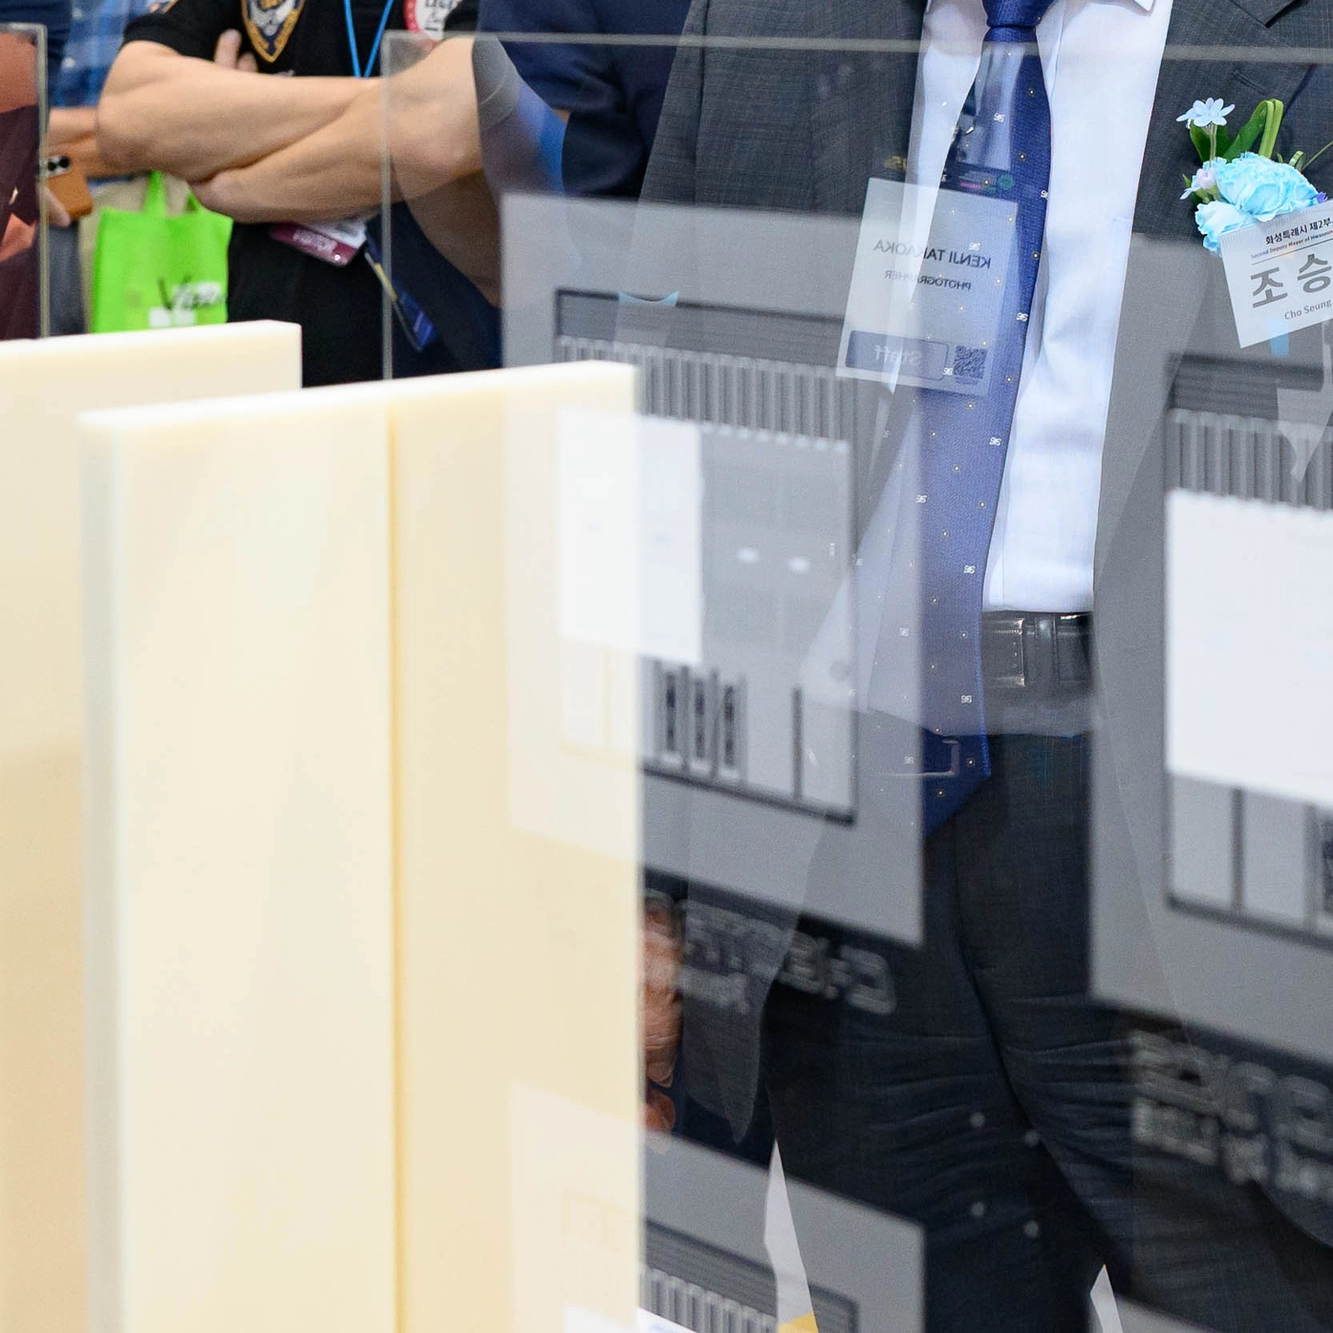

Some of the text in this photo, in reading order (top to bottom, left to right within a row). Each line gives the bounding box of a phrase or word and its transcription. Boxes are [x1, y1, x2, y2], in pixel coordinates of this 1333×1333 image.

[1265, 225, 1308, 245] 화성특례시
[1288, 239, 1304, 250] Mayor
[1284, 308, 1302, 320] Cho
[1304, 299, 1332, 314] Seung
